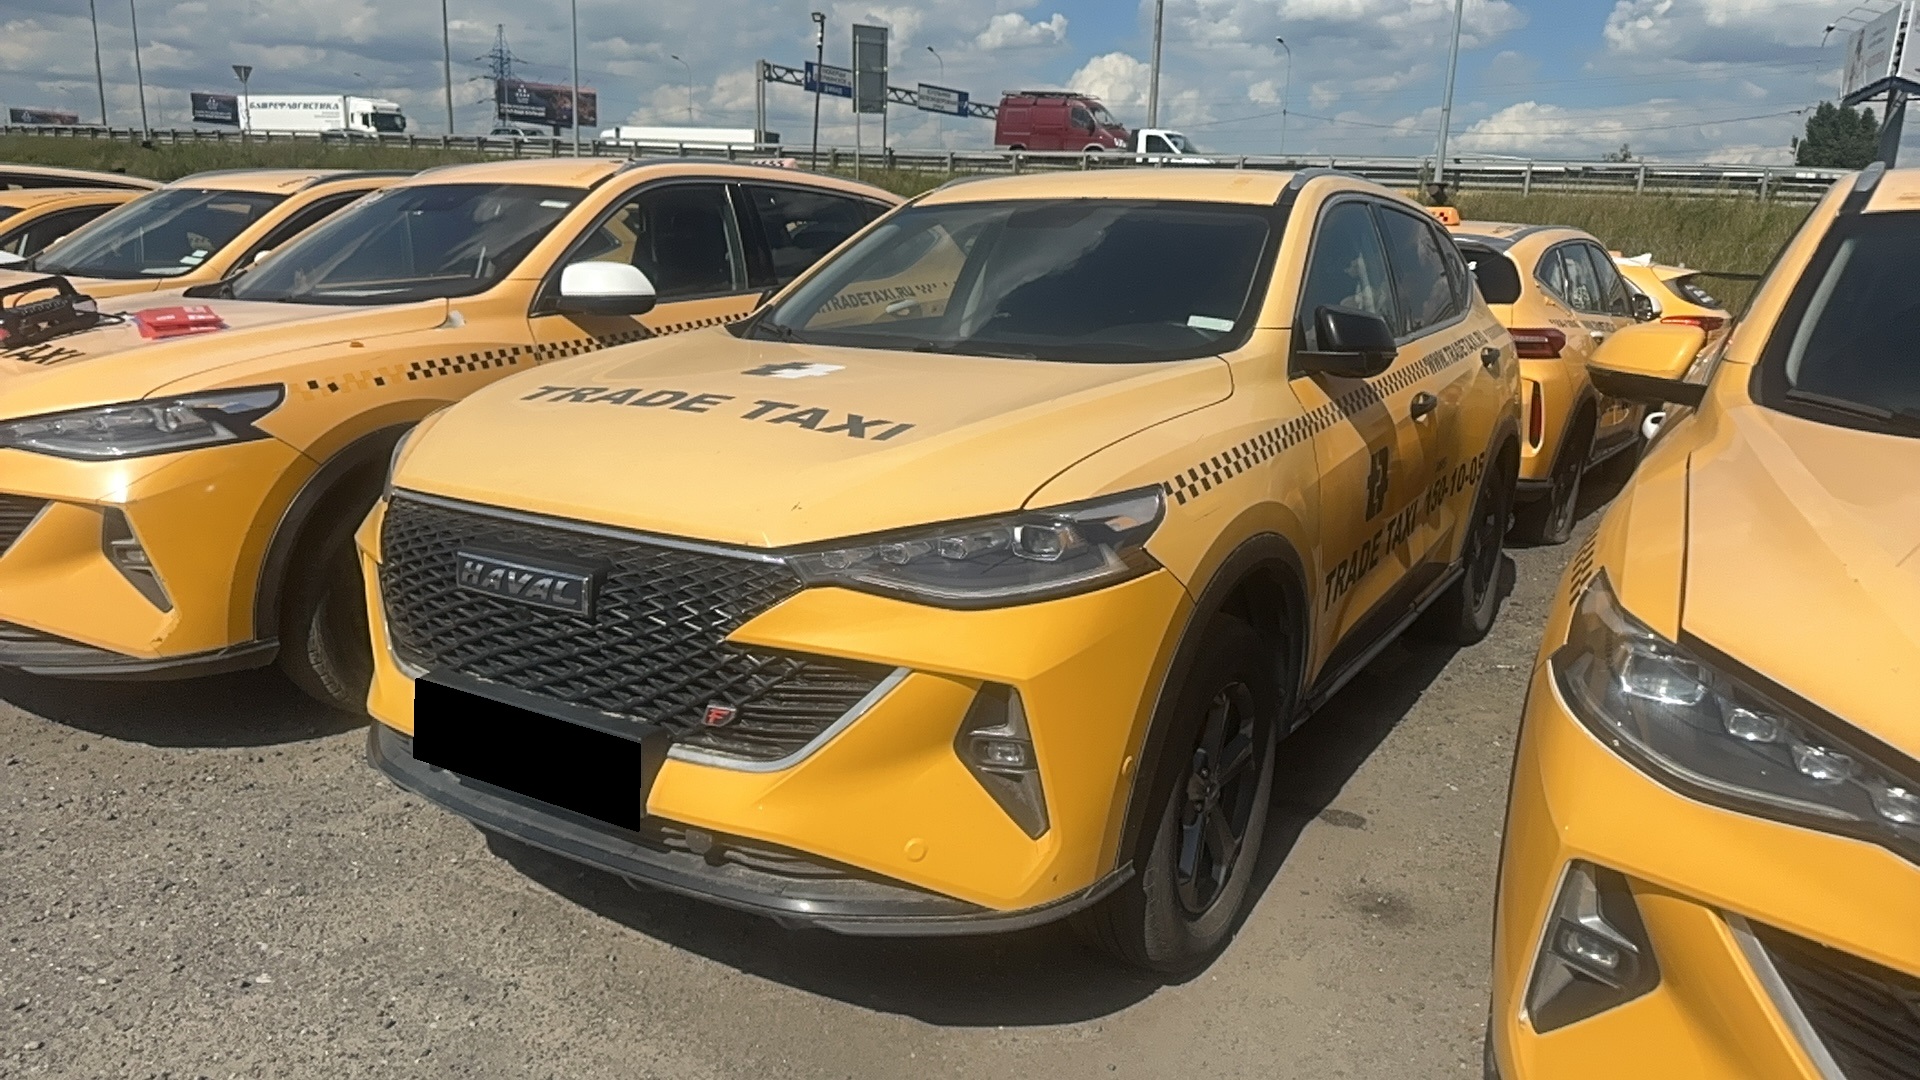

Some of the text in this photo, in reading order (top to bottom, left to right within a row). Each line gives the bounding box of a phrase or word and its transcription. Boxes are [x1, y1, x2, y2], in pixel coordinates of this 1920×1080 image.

[0, 343, 87, 366] AXI
[519, 385, 916, 442] TRADE TAXI
[1325, 499, 1419, 613] TRADE TAXI
[461, 560, 577, 605] HAVAL
[706, 706, 733, 725] F
